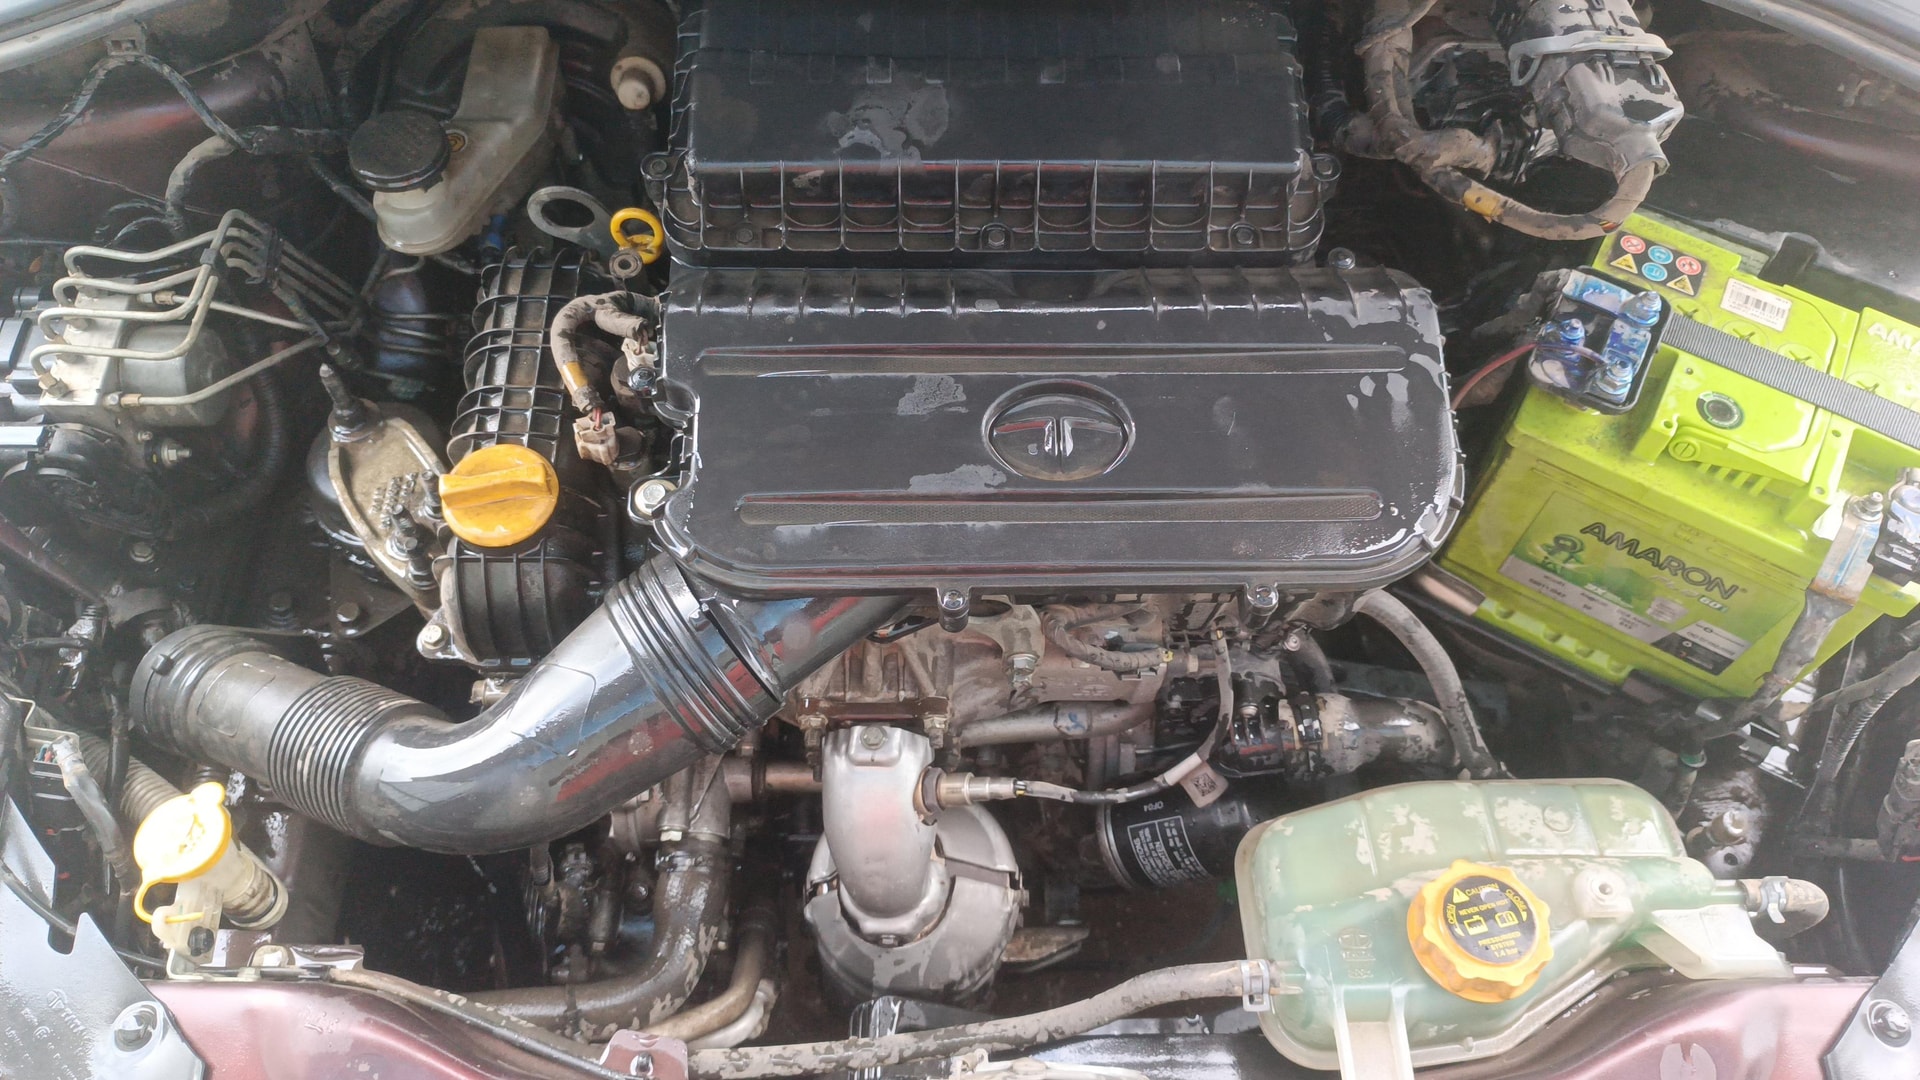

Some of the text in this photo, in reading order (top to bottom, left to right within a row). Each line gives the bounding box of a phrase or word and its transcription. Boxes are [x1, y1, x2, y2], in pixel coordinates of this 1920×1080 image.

[1579, 521, 1739, 600] AMARON
[1465, 883, 1499, 897] CAUTION
[1446, 903, 1456, 925] OPEN
[1458, 906, 1480, 916] NEVER
[1479, 902, 1496, 911] OPEN
